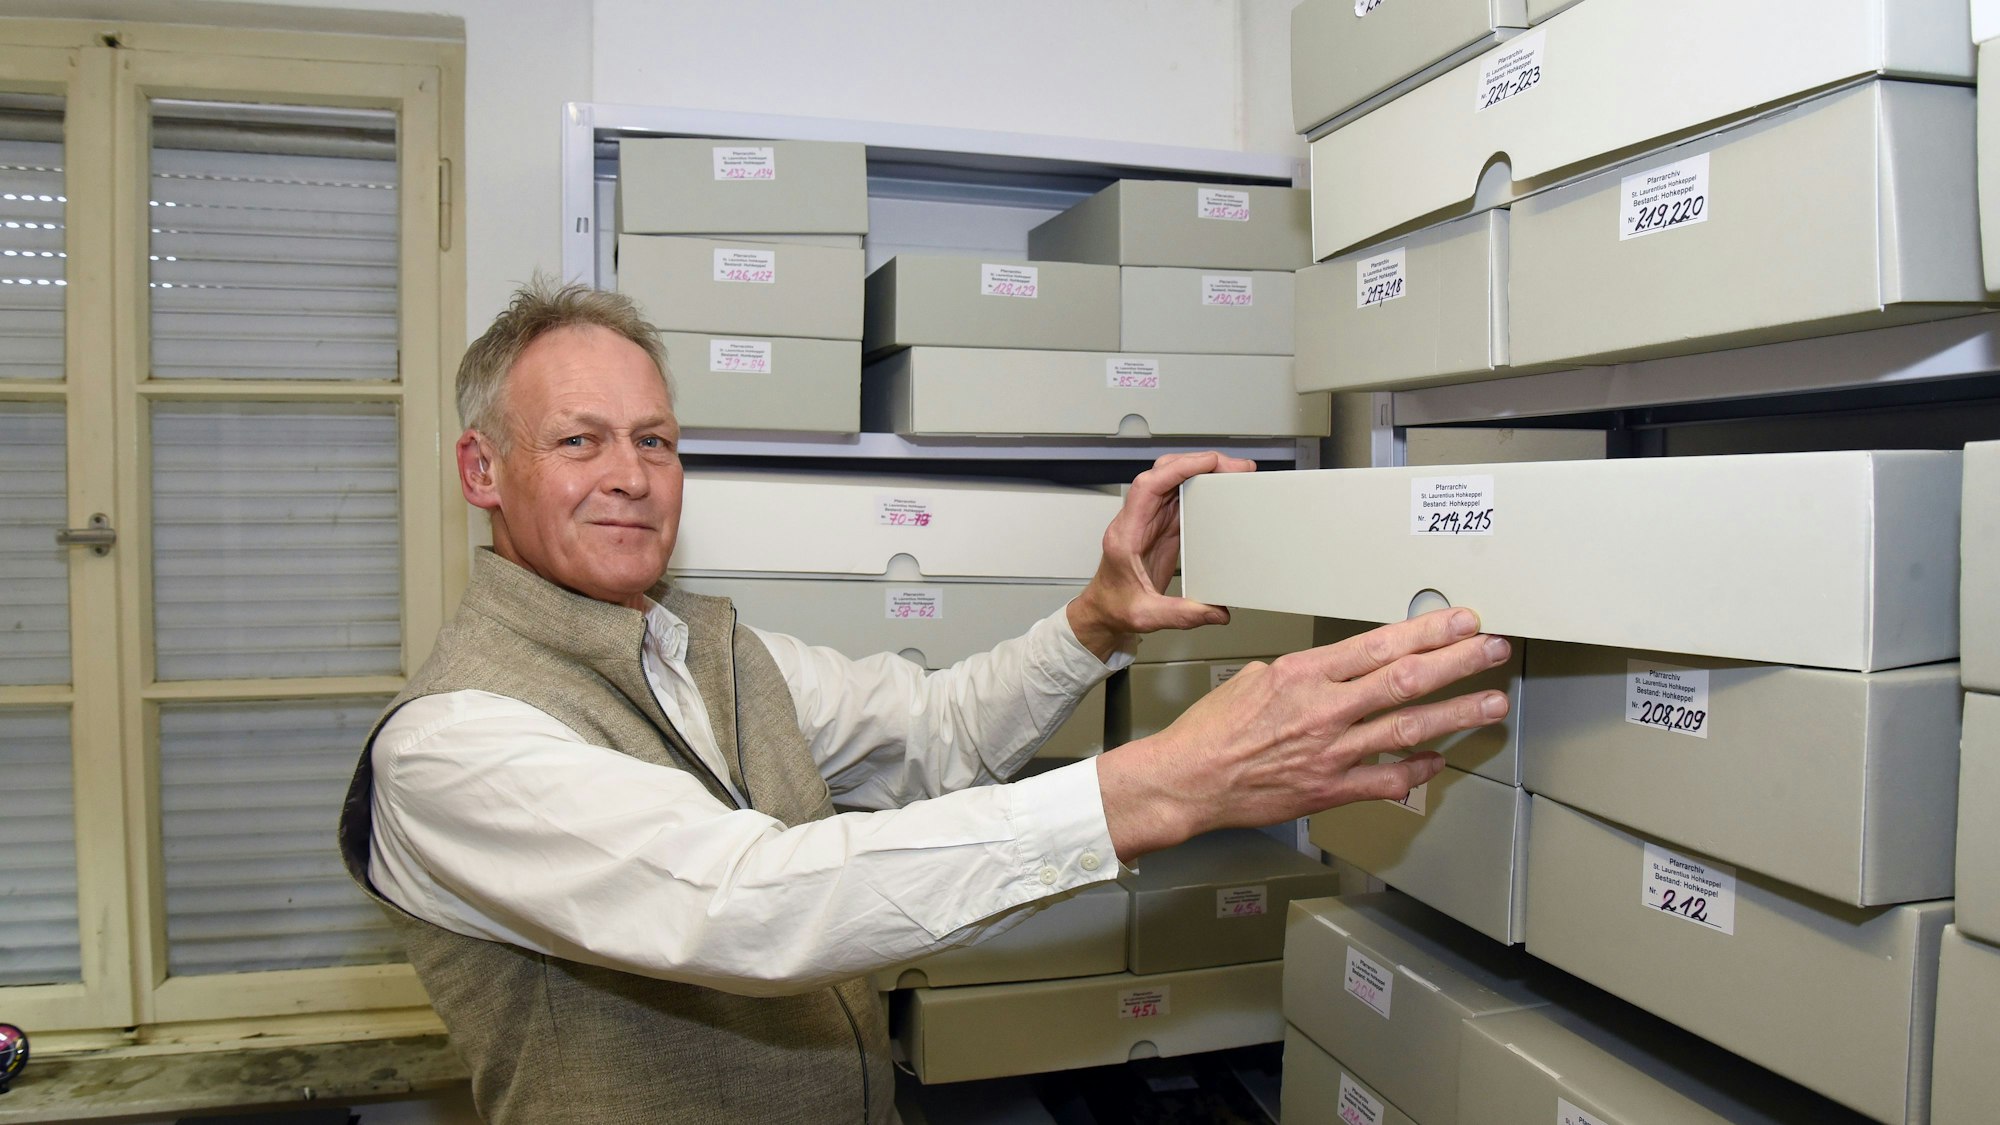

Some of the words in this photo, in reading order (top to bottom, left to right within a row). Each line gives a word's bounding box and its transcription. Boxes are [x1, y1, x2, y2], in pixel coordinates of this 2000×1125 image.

[1484, 66, 1540, 108] 221-223
[1639, 184, 1667, 196] Laurentius
[1668, 174, 1697, 187] Hohkeppel
[1647, 170, 1681, 185] Pfarrarchiv
[1633, 195, 1660, 207] Bestand:
[1661, 185, 1694, 200] Hohkeppel
[1627, 216, 1637, 224] Nr.
[1635, 195, 1704, 231] 219,220
[1435, 483, 1468, 491] Pfarrarchiv
[1449, 499, 1481, 508] Hohkeppel
[1428, 508, 1494, 534] 214,215
[1642, 678, 1668, 688] Laurentius
[1668, 683, 1696, 693] Hohkeppel
[1649, 669, 1681, 681] Pfarrarchiv
[1636, 686, 1661, 697] Bestand:
[1662, 691, 1694, 703] Hohkeppel
[1631, 701, 1640, 709] Nr.
[1640, 700, 1706, 731] 208,209
[1669, 857, 1705, 874] Pfarrarchiv
[1655, 872, 1682, 886] Bestand:
[1683, 882, 1718, 898] Hohkeppel
[1661, 866, 1690, 880] Laurentius
[1691, 875, 1722, 889] Hohkeppel
[1649, 886, 1658, 895] Nr.
[1661, 889, 1707, 922] 212
